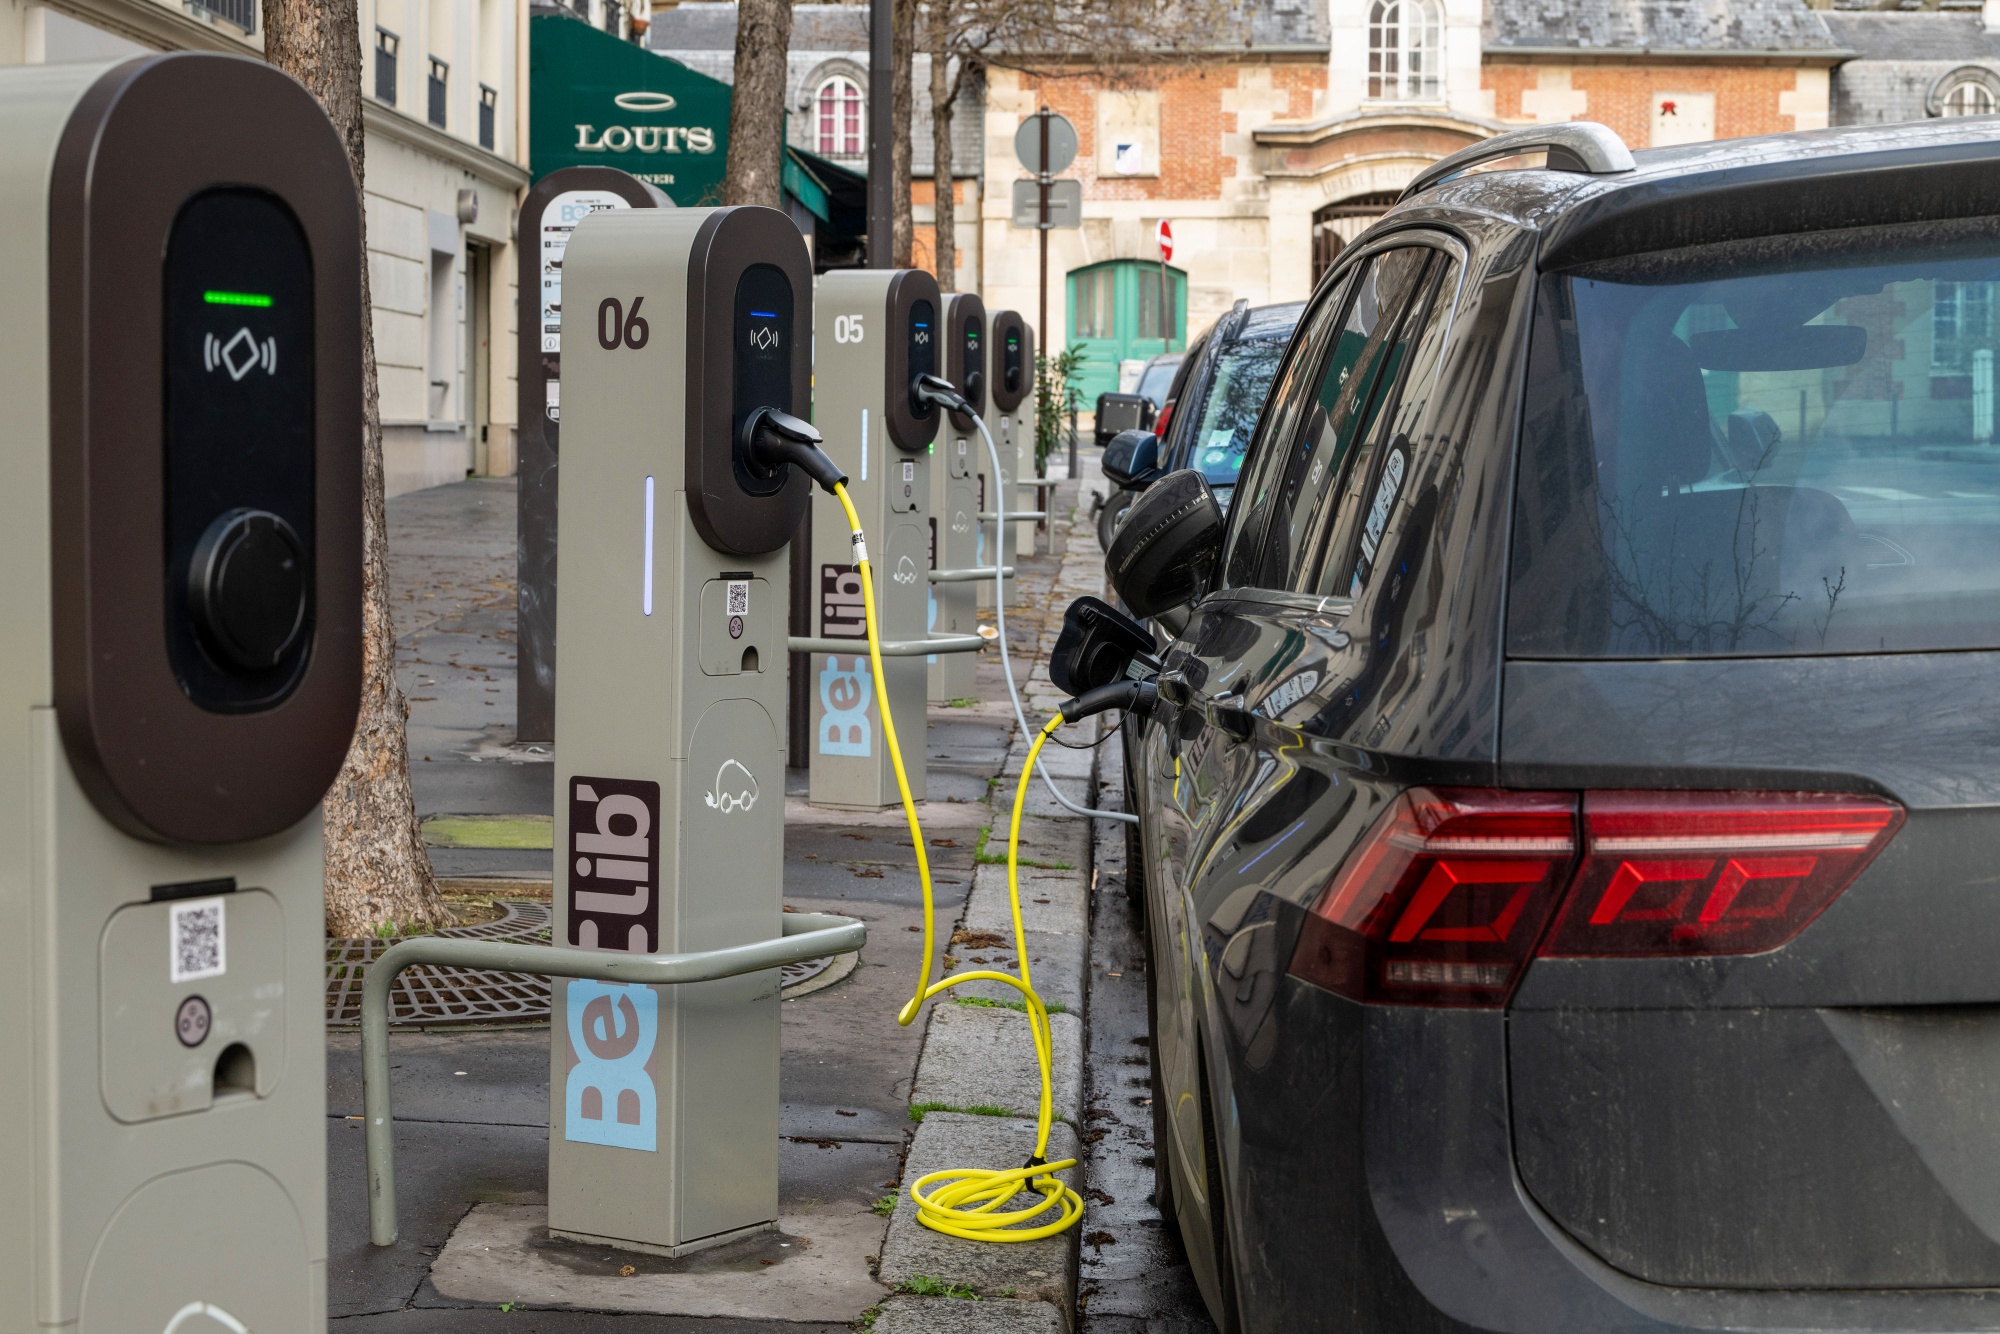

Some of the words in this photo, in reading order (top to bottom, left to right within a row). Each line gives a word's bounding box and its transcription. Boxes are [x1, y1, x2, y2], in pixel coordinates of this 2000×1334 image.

[632, 173, 676, 185] RNER
[598, 297, 649, 350] 06
[834, 315, 864, 344] 05
